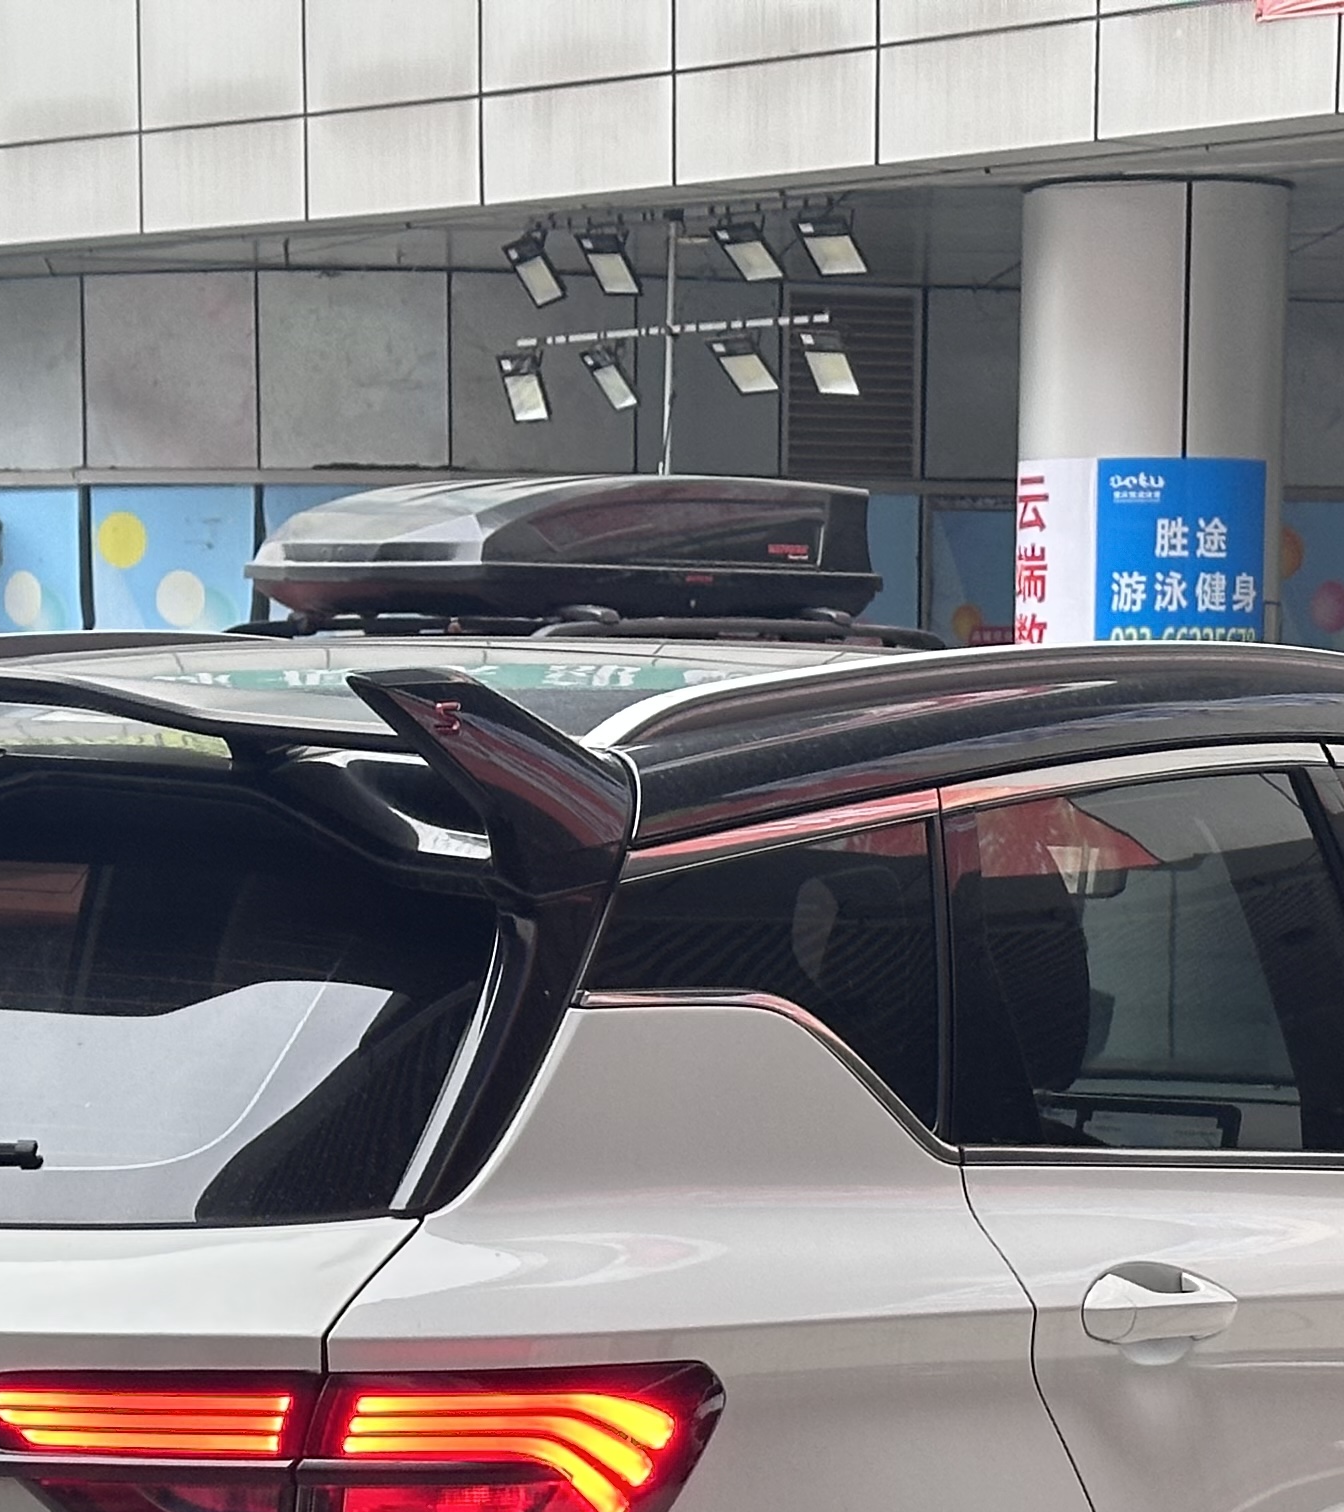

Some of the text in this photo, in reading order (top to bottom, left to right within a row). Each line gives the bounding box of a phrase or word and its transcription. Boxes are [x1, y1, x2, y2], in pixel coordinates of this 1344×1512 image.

[1154, 516, 1228, 558] 胜途
[1110, 570, 1257, 613] 游泳健身
